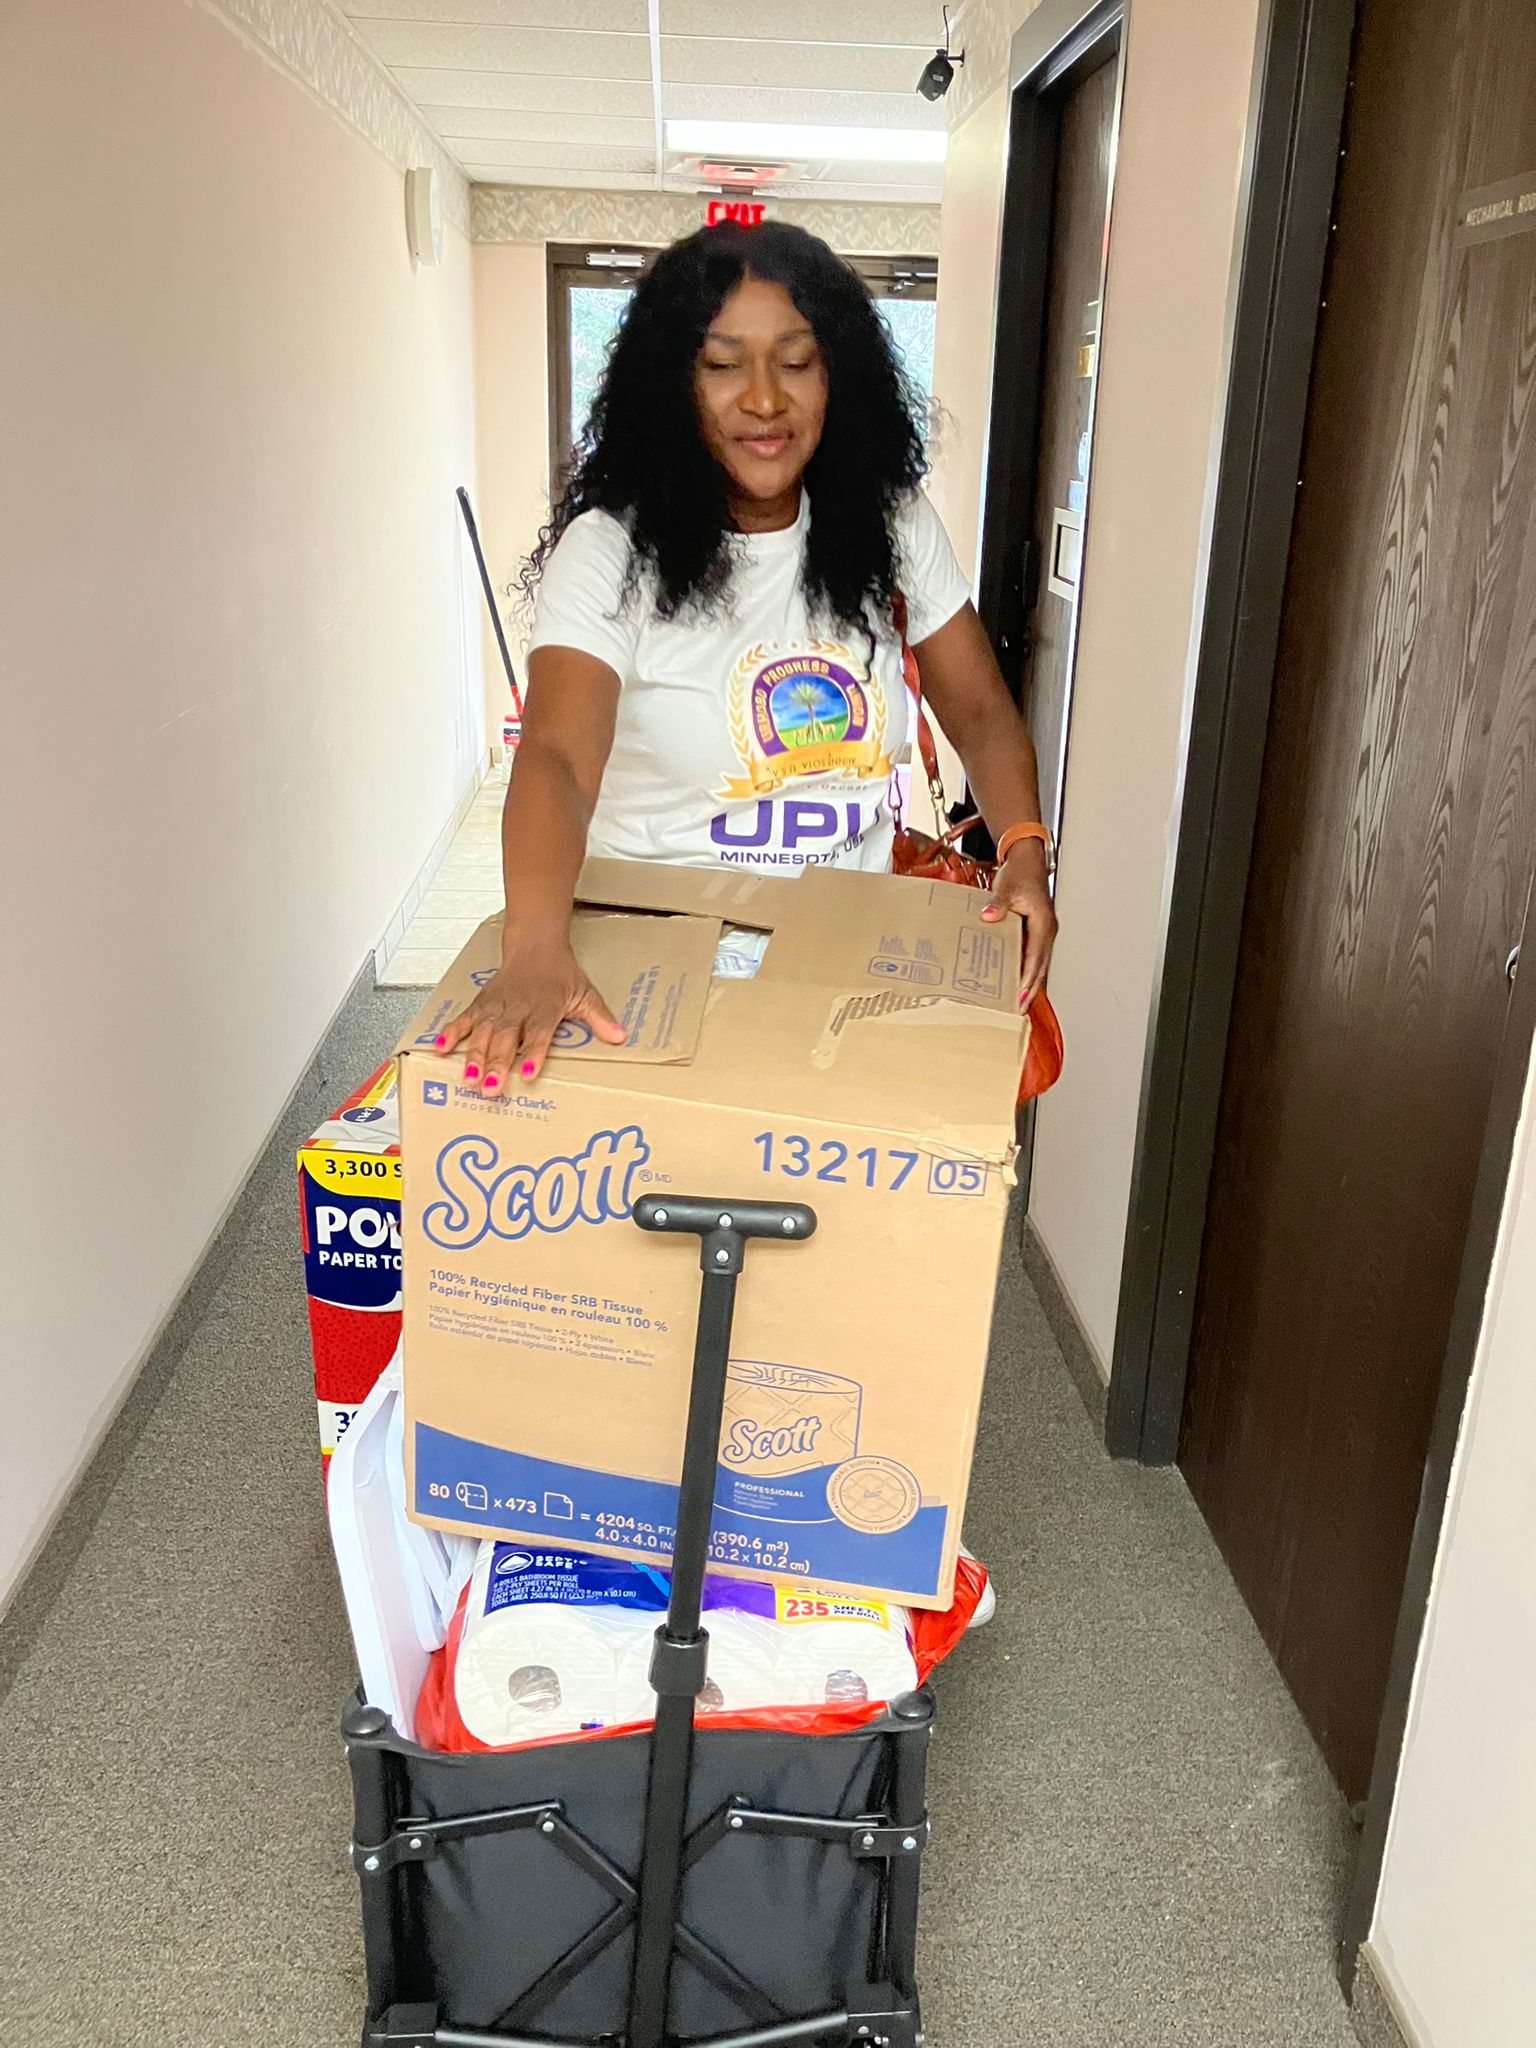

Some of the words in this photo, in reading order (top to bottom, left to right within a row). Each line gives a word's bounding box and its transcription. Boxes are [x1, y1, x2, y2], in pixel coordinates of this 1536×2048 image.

[720, 851, 839, 866] MINNESOTA
[454, 1100, 550, 1122] PROFESSIONAL
[325, 1159, 387, 1179] 3,300
[754, 1131, 918, 1191] 13217
[933, 1159, 981, 1191] 05
[422, 1125, 651, 1250] Scott
[319, 1250, 378, 1269] PAPER
[430, 1269, 466, 1285] 100%
[470, 1276, 528, 1296] Recycled
[532, 1287, 567, 1302] Fiber
[571, 1294, 597, 1308] SRB
[601, 1299, 643, 1315] Tissue
[429, 1281, 471, 1297] Papier
[474, 1290, 546, 1312] hygiénique
[550, 1306, 567, 1316] en
[571, 1309, 621, 1325] rouleau
[626, 1317, 650, 1329] 100
[654, 1320, 668, 1332] %
[452, 1309, 486, 1321] Recycled
[529, 1323, 553, 1333] Tissue
[335, 1411, 358, 1433] 3
[722, 1416, 822, 1464] Scott
[735, 1481, 804, 1498] PROFESSIONAL
[429, 1483, 450, 1498] 80
[505, 1497, 537, 1514] 473
[596, 1512, 635, 1529] 4204
[637, 1522, 656, 1533] SQ.
[595, 1528, 620, 1541] 4.0
[622, 1535, 630, 1544] x
[633, 1533, 657, 1547] 4.0
[713, 1530, 762, 1549] (390.6
[708, 1545, 739, 1561] 10.2
[742, 1554, 750, 1562] x
[754, 1553, 787, 1568] 10.2
[790, 1559, 810, 1574] cm)
[557, 1574, 579, 1582] TISSUE
[786, 1599, 829, 1617] 235
